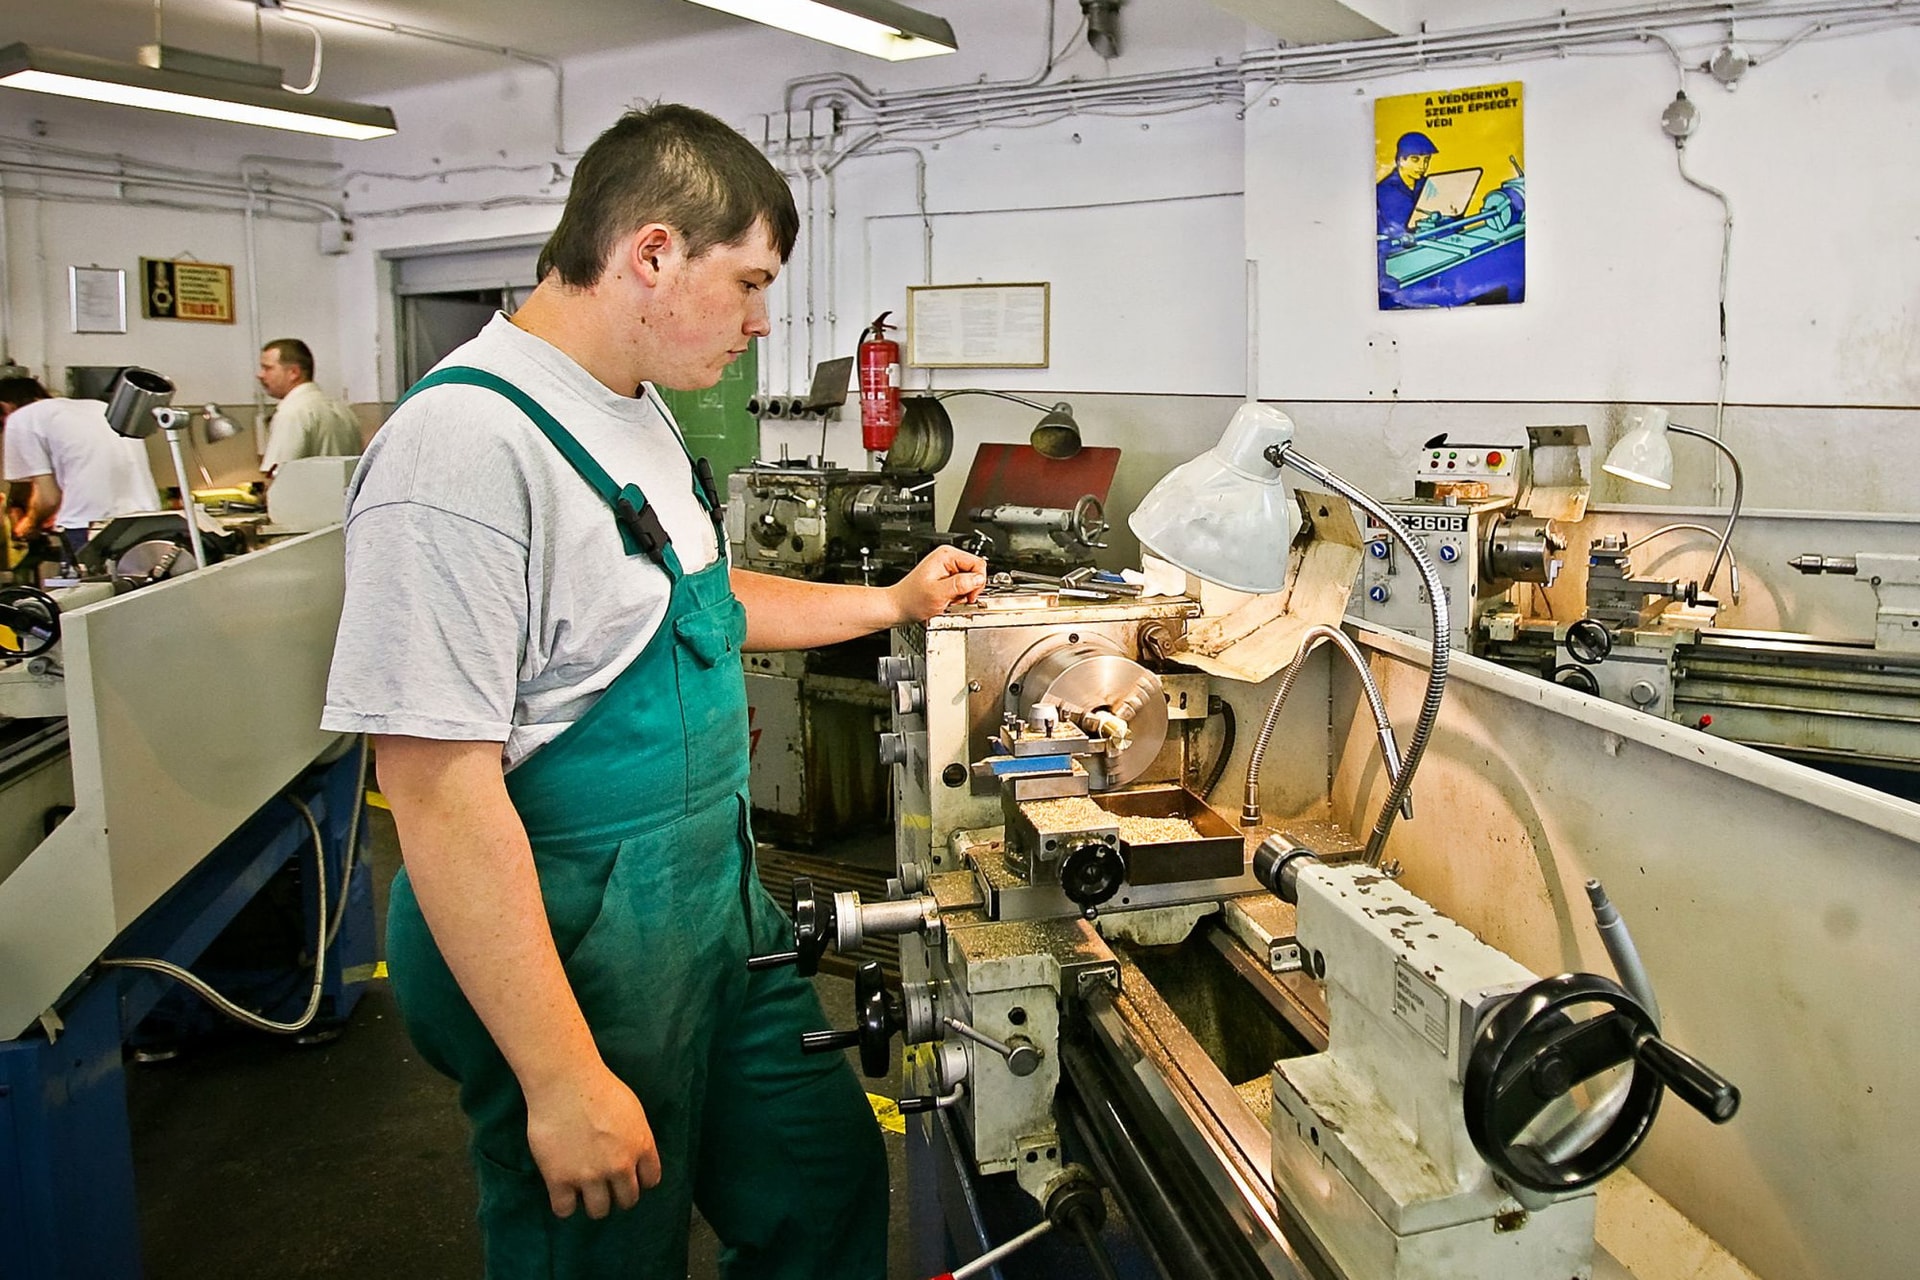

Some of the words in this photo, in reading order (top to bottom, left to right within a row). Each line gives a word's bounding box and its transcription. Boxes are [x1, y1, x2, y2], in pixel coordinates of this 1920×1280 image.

[1425, 97, 1433, 106] A
[1425, 105, 1464, 117] SZEME
[1426, 117, 1453, 128] VÉDI
